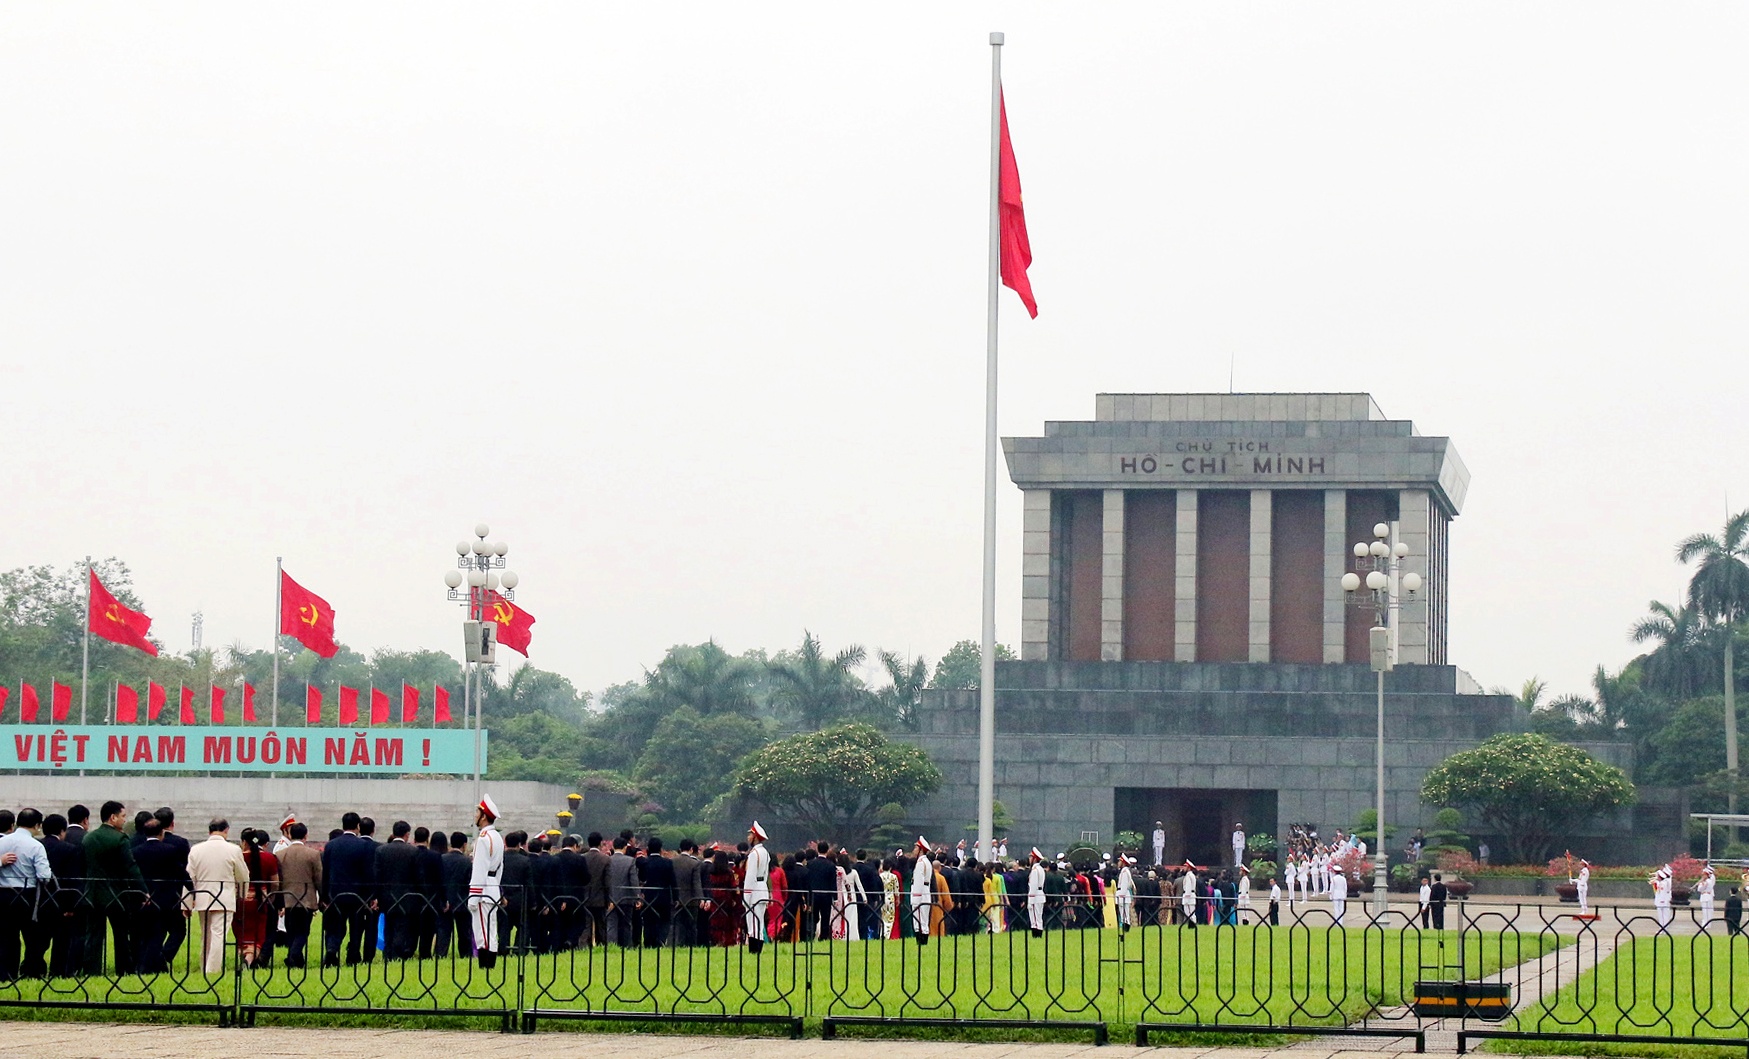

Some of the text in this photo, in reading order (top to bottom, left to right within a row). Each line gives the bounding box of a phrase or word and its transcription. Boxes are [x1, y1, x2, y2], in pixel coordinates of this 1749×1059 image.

[1181, 457, 1227, 474] CHI
[14, 729, 90, 767] VIỆT
[107, 735, 186, 763] NAM
[203, 731, 307, 765] MUÔN
[325, 731, 403, 766] NĂM
